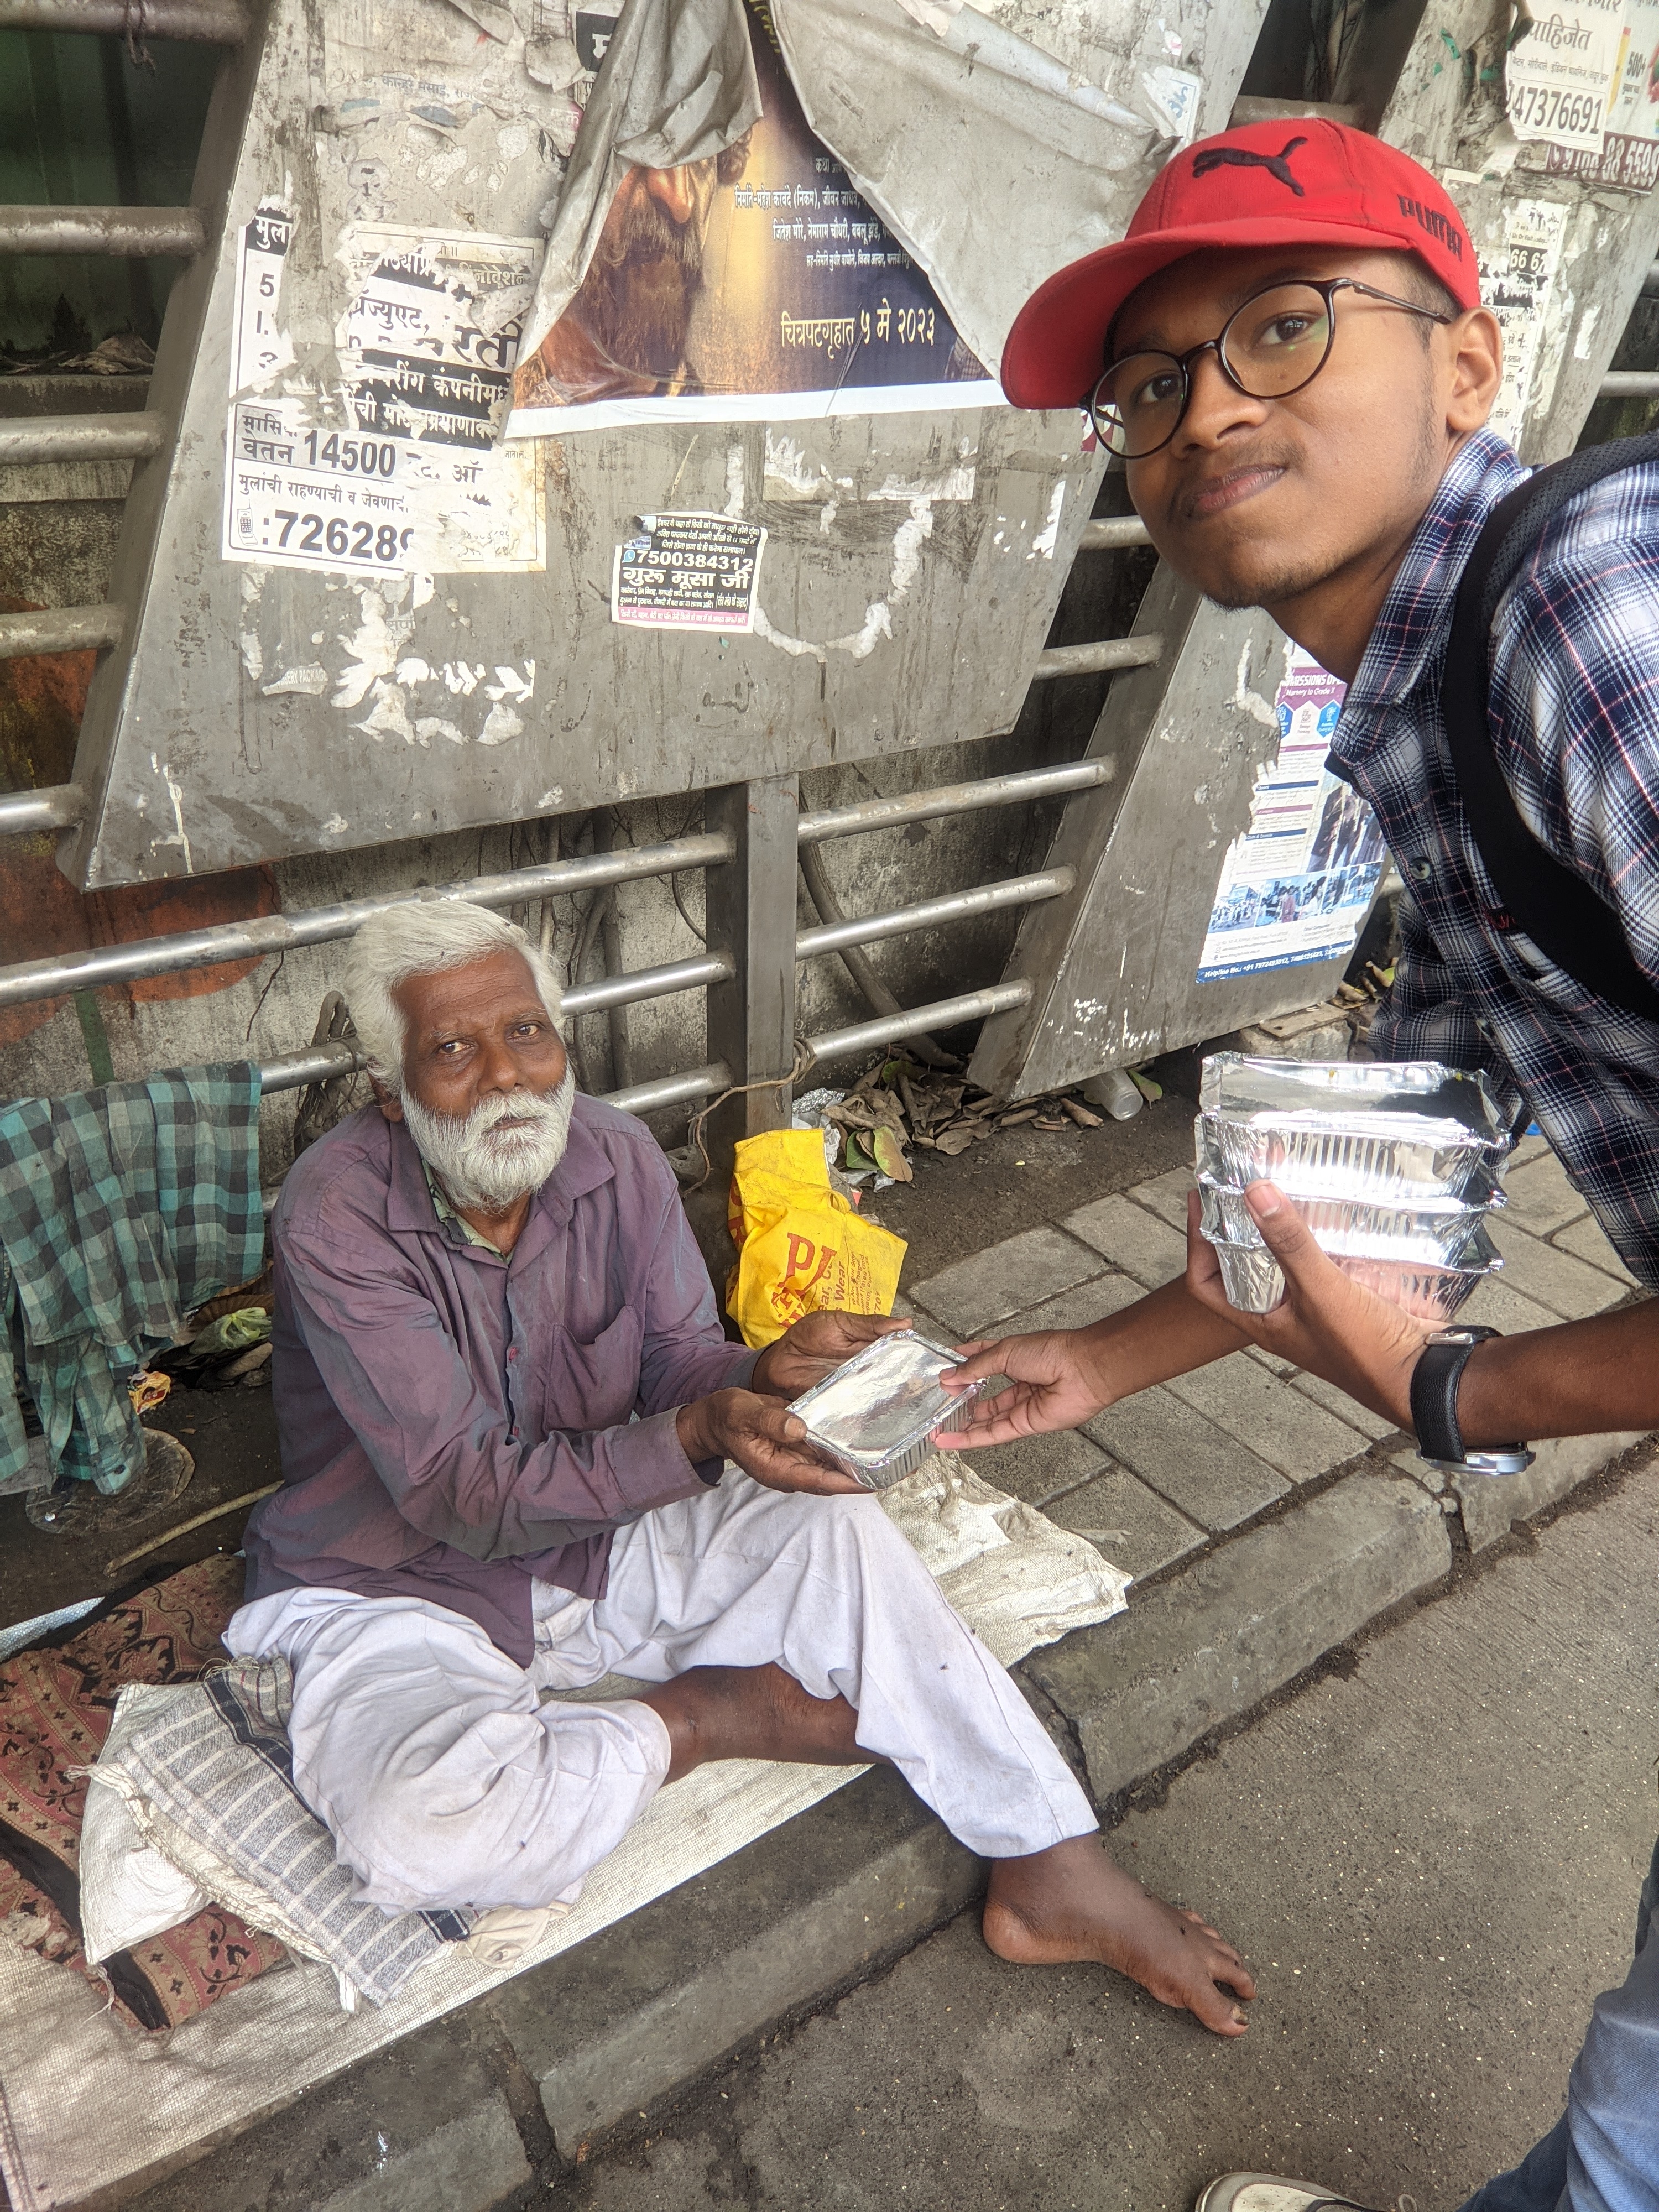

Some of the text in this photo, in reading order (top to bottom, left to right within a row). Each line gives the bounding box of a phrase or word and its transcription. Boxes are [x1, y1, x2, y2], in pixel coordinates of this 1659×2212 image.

[1397, 194, 1463, 262] PUMA
[781, 310, 855, 359] चित्रपटगृहात
[877, 298, 891, 343] मे
[898, 307, 935, 346] २०२३
[242, 413, 298, 437] मासि
[242, 429, 295, 465] वेतन
[304, 430, 396, 478] 14500
[238, 472, 283, 495] मुलांची
[288, 483, 343, 504] राहण्याची
[347, 490, 357, 505] व
[637, 550, 754, 572] 7500384312
[671, 570, 716, 589] मूसा
[720, 570, 750, 589] जी
[1286, 688, 1307, 697] Nursery
[1204, 969, 1229, 978] Helpline
[834, 1260, 846, 1301] Wear
